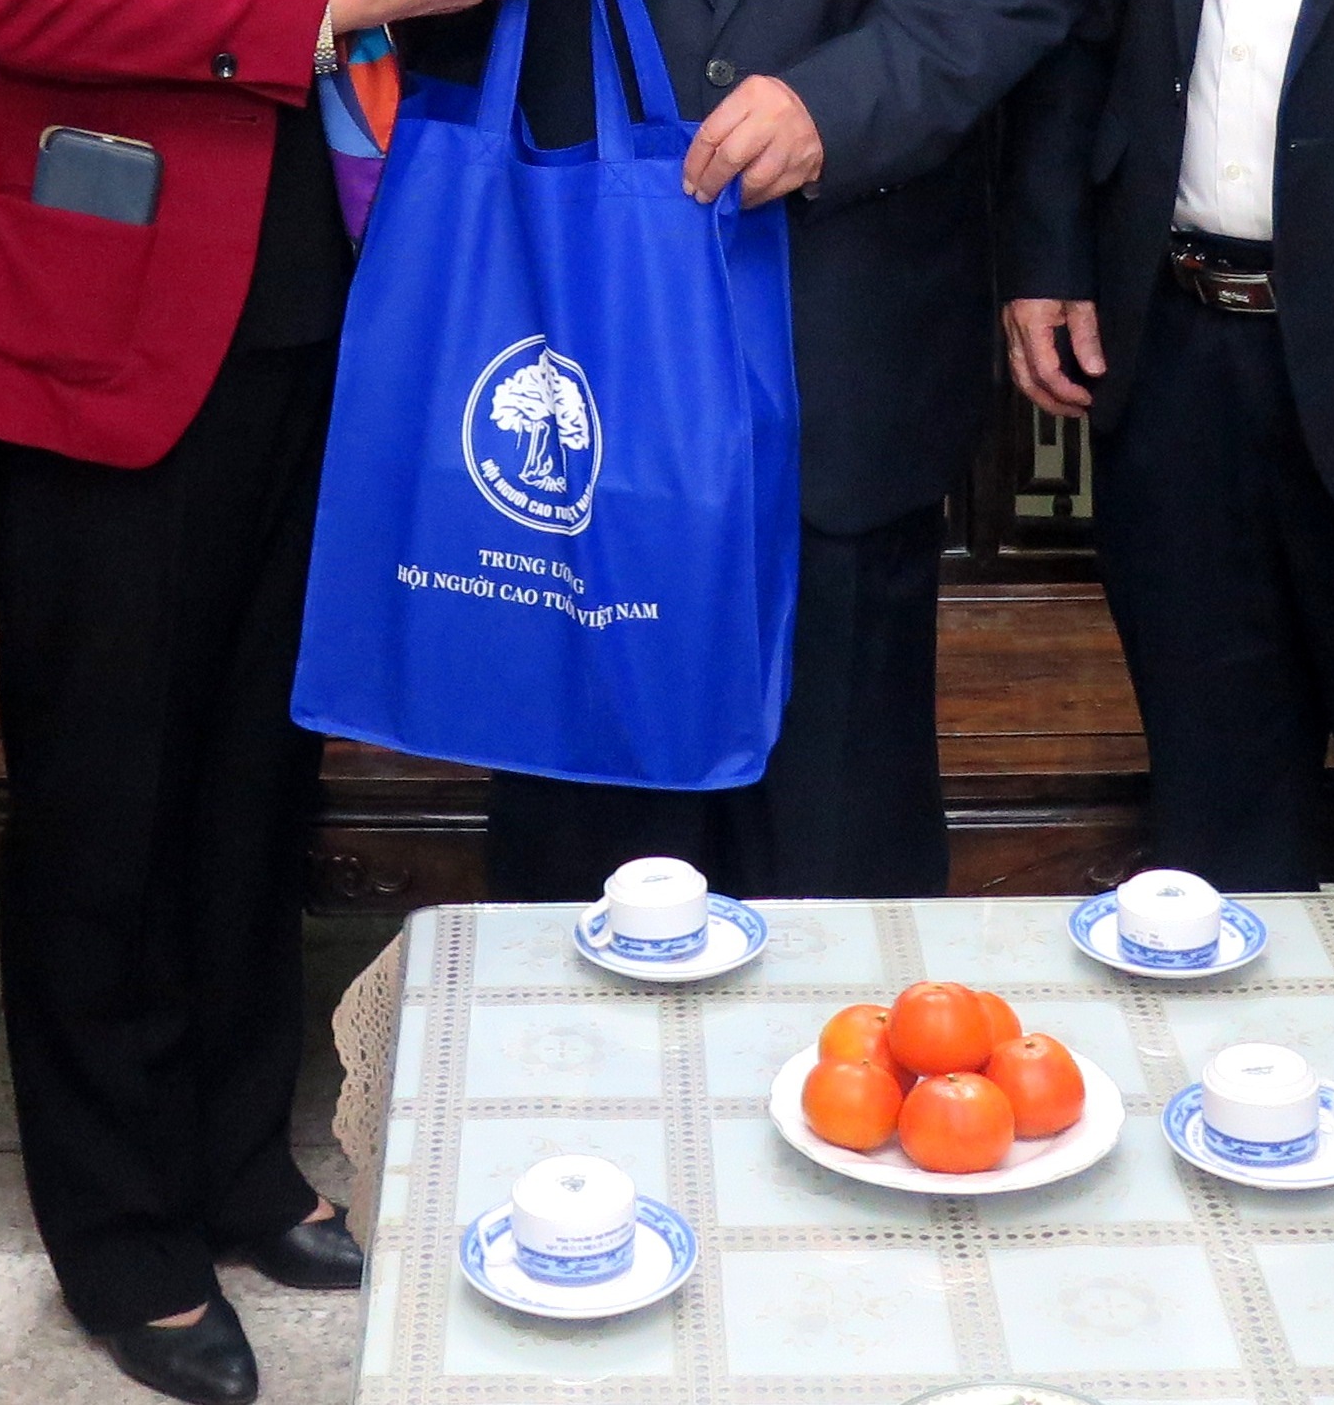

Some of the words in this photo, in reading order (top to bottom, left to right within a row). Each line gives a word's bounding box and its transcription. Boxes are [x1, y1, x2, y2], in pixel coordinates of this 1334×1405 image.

[527, 499, 553, 518] CAO
[478, 548, 547, 576] TRUNG
[397, 563, 429, 591] HỘI
[433, 571, 496, 600] NGƯỜI
[499, 583, 539, 606] CAO
[576, 604, 613, 631] VIỆT
[615, 602, 660, 621] NAM
